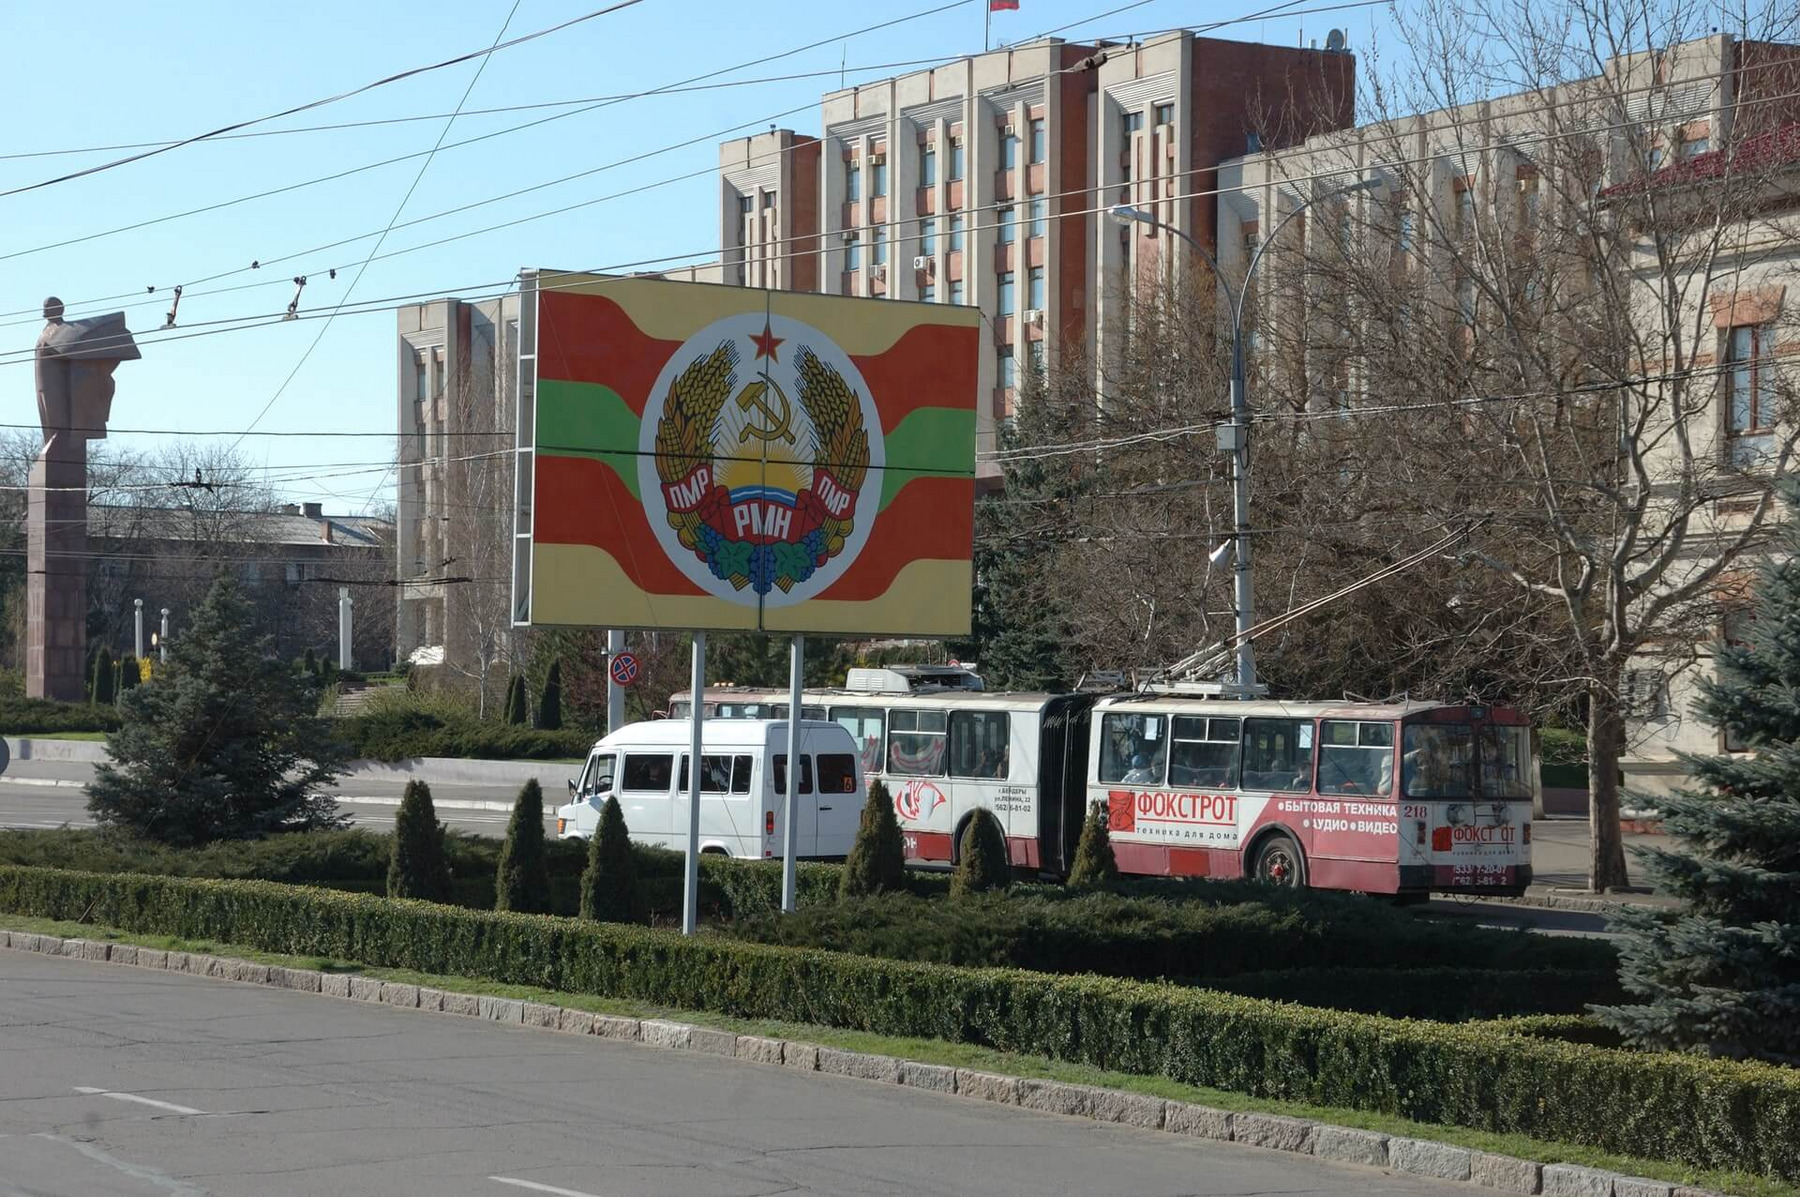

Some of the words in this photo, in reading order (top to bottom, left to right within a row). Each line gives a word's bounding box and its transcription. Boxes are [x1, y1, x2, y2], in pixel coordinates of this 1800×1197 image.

[669, 468, 709, 509] ПМР
[817, 475, 850, 515] ПМР
[733, 503, 793, 540] РМН
[1137, 791, 1238, 821] ФОКСТРОТ
[1285, 800, 1340, 814] БЫТОВАЯ
[1343, 803, 1398, 817] ТЕХНИКА
[1404, 805, 1428, 818] 218
[1184, 830, 1204, 838] для
[1208, 832, 1238, 840] дома
[1357, 820, 1398, 835] ВИДЕО
[1454, 826, 1516, 842] ФОКСТОТ
